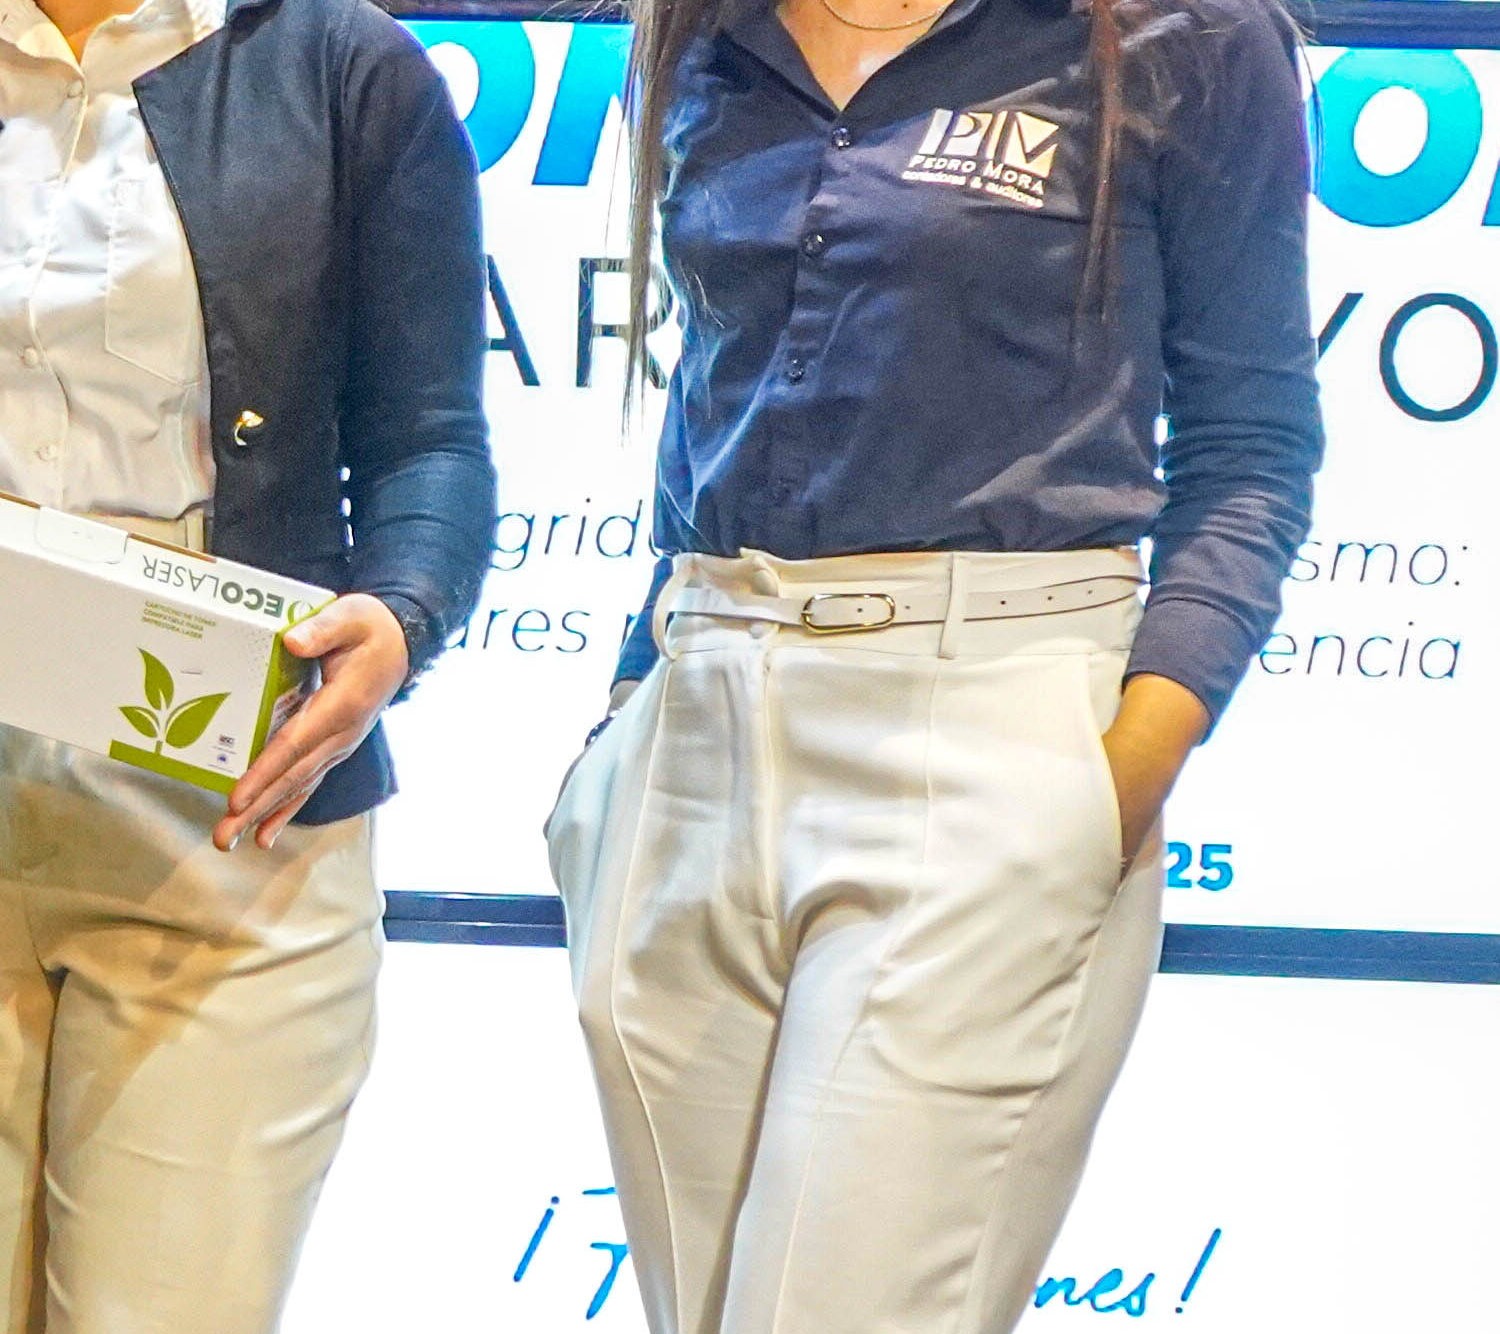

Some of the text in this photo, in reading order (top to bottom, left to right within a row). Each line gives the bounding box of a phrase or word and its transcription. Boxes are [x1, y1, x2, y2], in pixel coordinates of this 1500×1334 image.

[907, 154, 1046, 196] PEDRO MORA
[141, 554, 286, 619] ECOLASER
